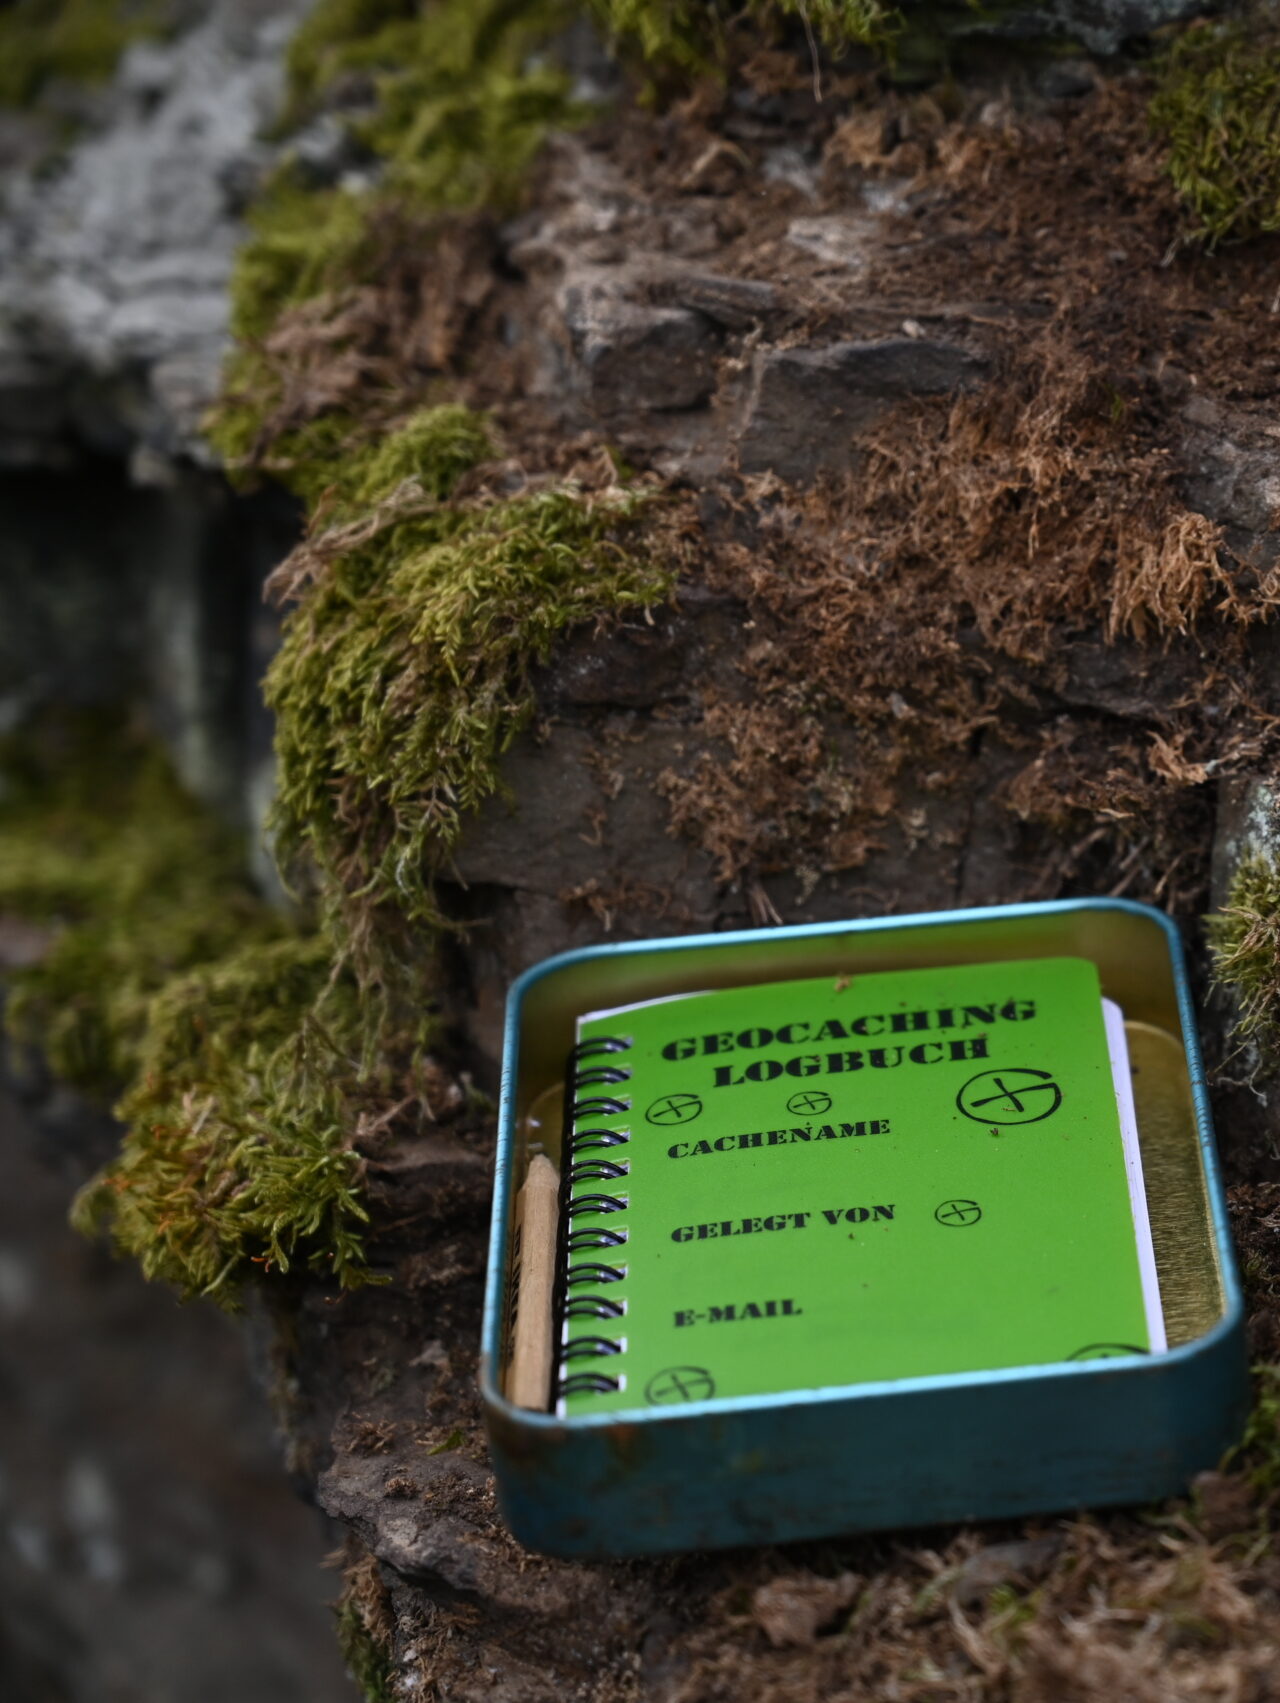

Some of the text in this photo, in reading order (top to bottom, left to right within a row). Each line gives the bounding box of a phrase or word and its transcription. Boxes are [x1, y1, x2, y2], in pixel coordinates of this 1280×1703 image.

[661, 1000, 1037, 1061] GEOCACHING
[713, 1018, 991, 1088] LOGBUCH
[667, 1119, 891, 1159] CACHENAME
[671, 1204, 896, 1243] GELEGT VON
[673, 1299, 803, 1328] E-MAIL
